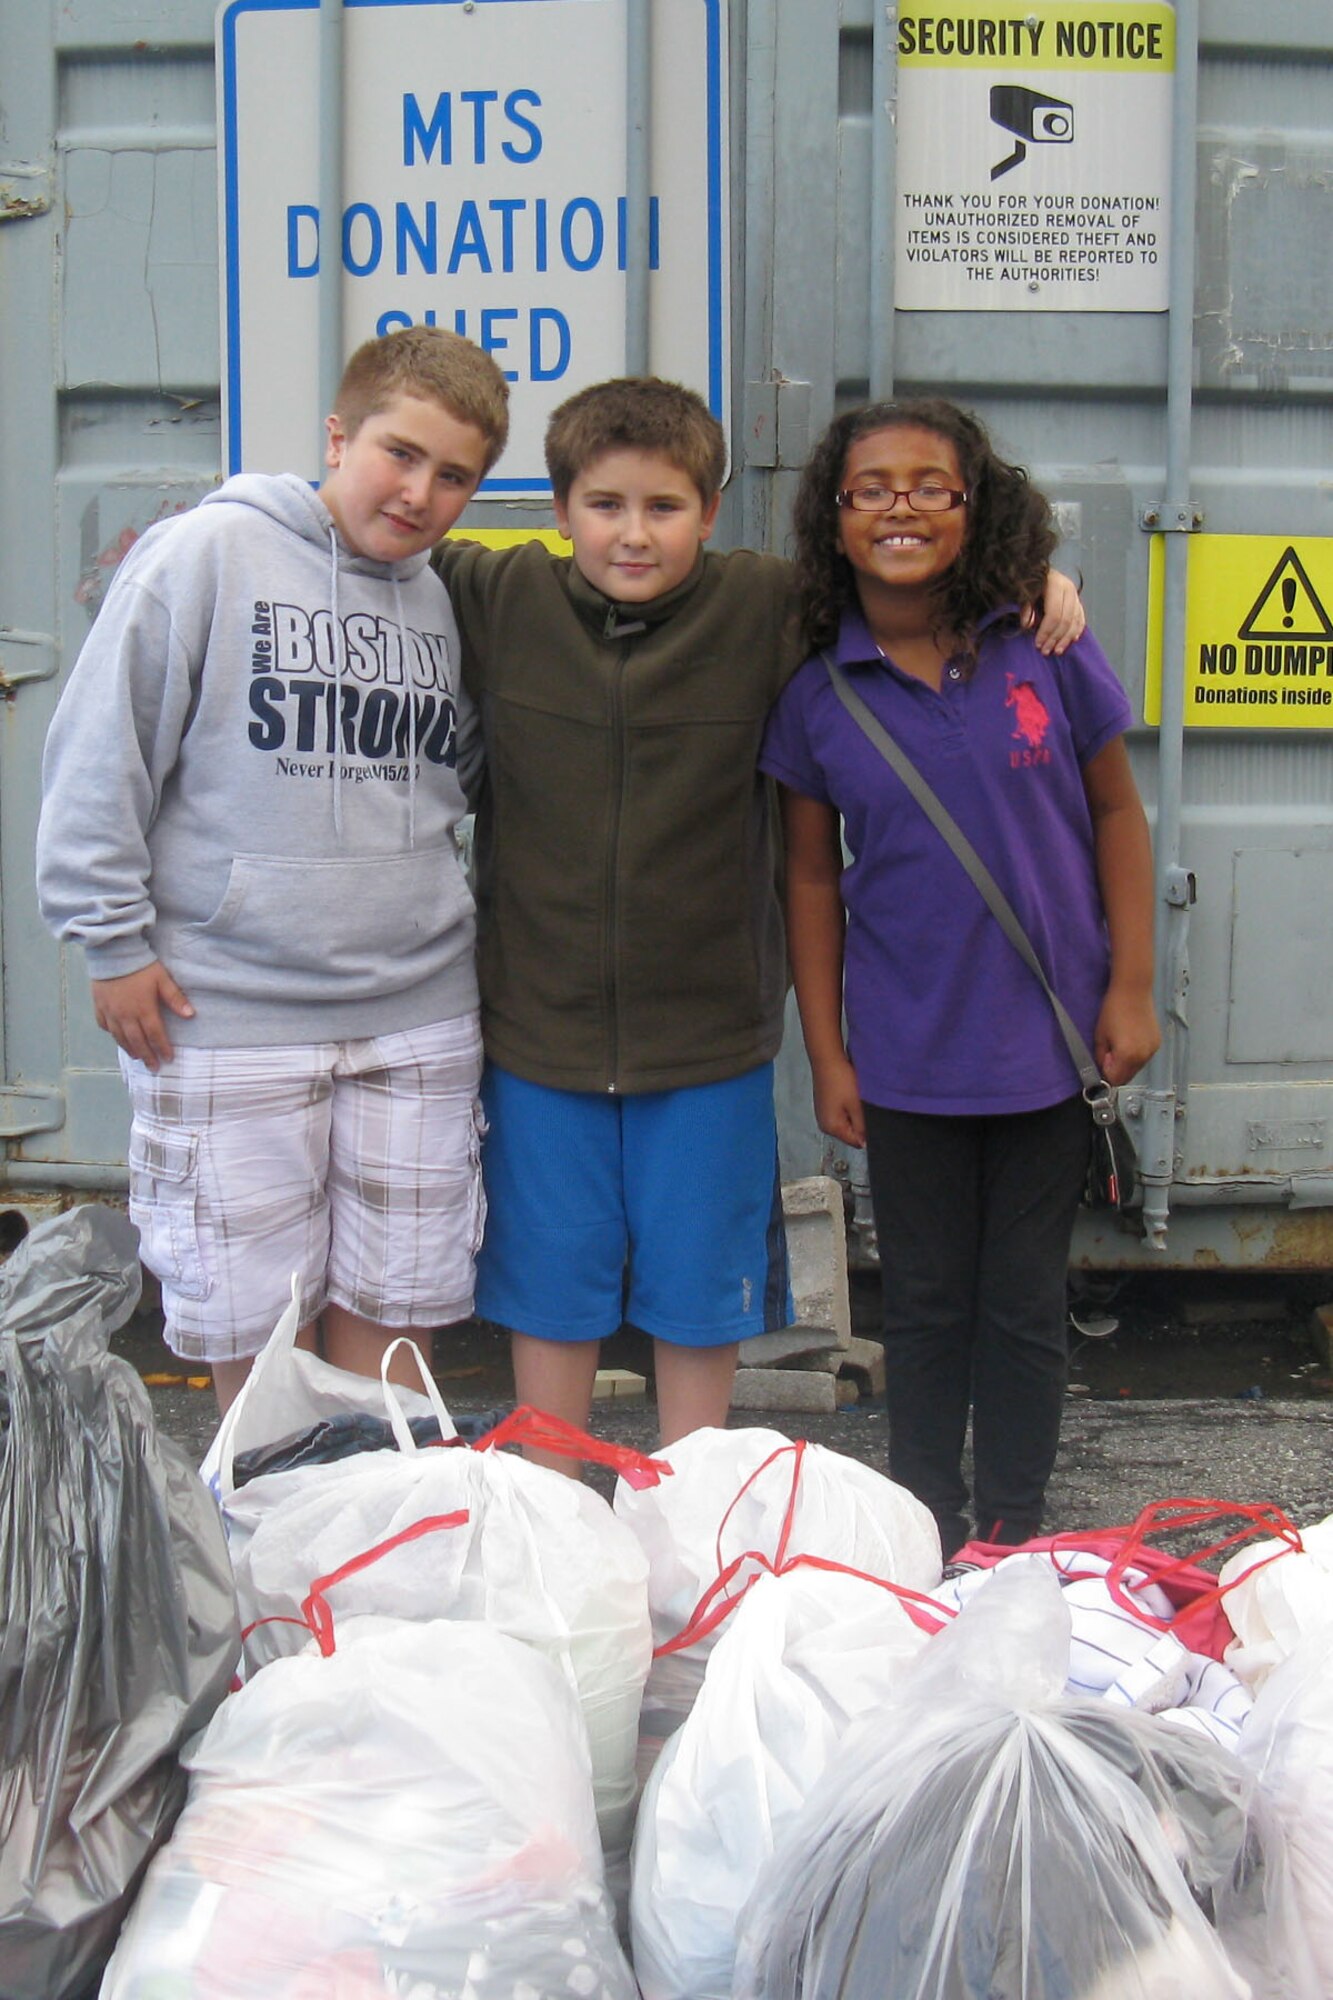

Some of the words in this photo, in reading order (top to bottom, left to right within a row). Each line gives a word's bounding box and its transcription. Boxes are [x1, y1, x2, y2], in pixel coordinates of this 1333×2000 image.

[899, 18, 1044, 56] SECURITY
[1056, 21, 1162, 59] NOTICE
[403, 89, 543, 165] MTS
[904, 194, 954, 208] THANK
[961, 195, 991, 208] YOU
[999, 196, 1027, 208] FOR
[1033, 196, 1074, 210] YOUR
[1081, 197, 1159, 210] DONATION!
[925, 213, 1039, 227] UNAUTHORIZED
[1046, 214, 1115, 228] REMOVAL
[1122, 215, 1140, 228] OF
[908, 231, 950, 244] ITEMS
[957, 231, 970, 244] IS
[976, 232, 1069, 245] CONSIDERED
[1076, 232, 1119, 246] THEFT
[1126, 233, 1156, 246] AND
[907, 249, 988, 262] VIOLATORS
[994, 250, 1028, 262] WILL
[1034, 250, 1052, 263] BE
[1059, 250, 1134, 264] REPORTED
[1140, 251, 1157, 264] TO
[966, 268, 994, 280] THE
[1001, 268, 1100, 281] AUTHORITIES!
[252, 601, 271, 636] Are
[252, 640, 271, 674] We
[273, 603, 454, 698] BOSTON
[1200, 644, 1237, 675] NO
[1195, 686, 1277, 704] Donations
[1282, 687, 1331, 705] inside
[248, 677, 456, 769] STRONG
[275, 757, 323, 778] Never
